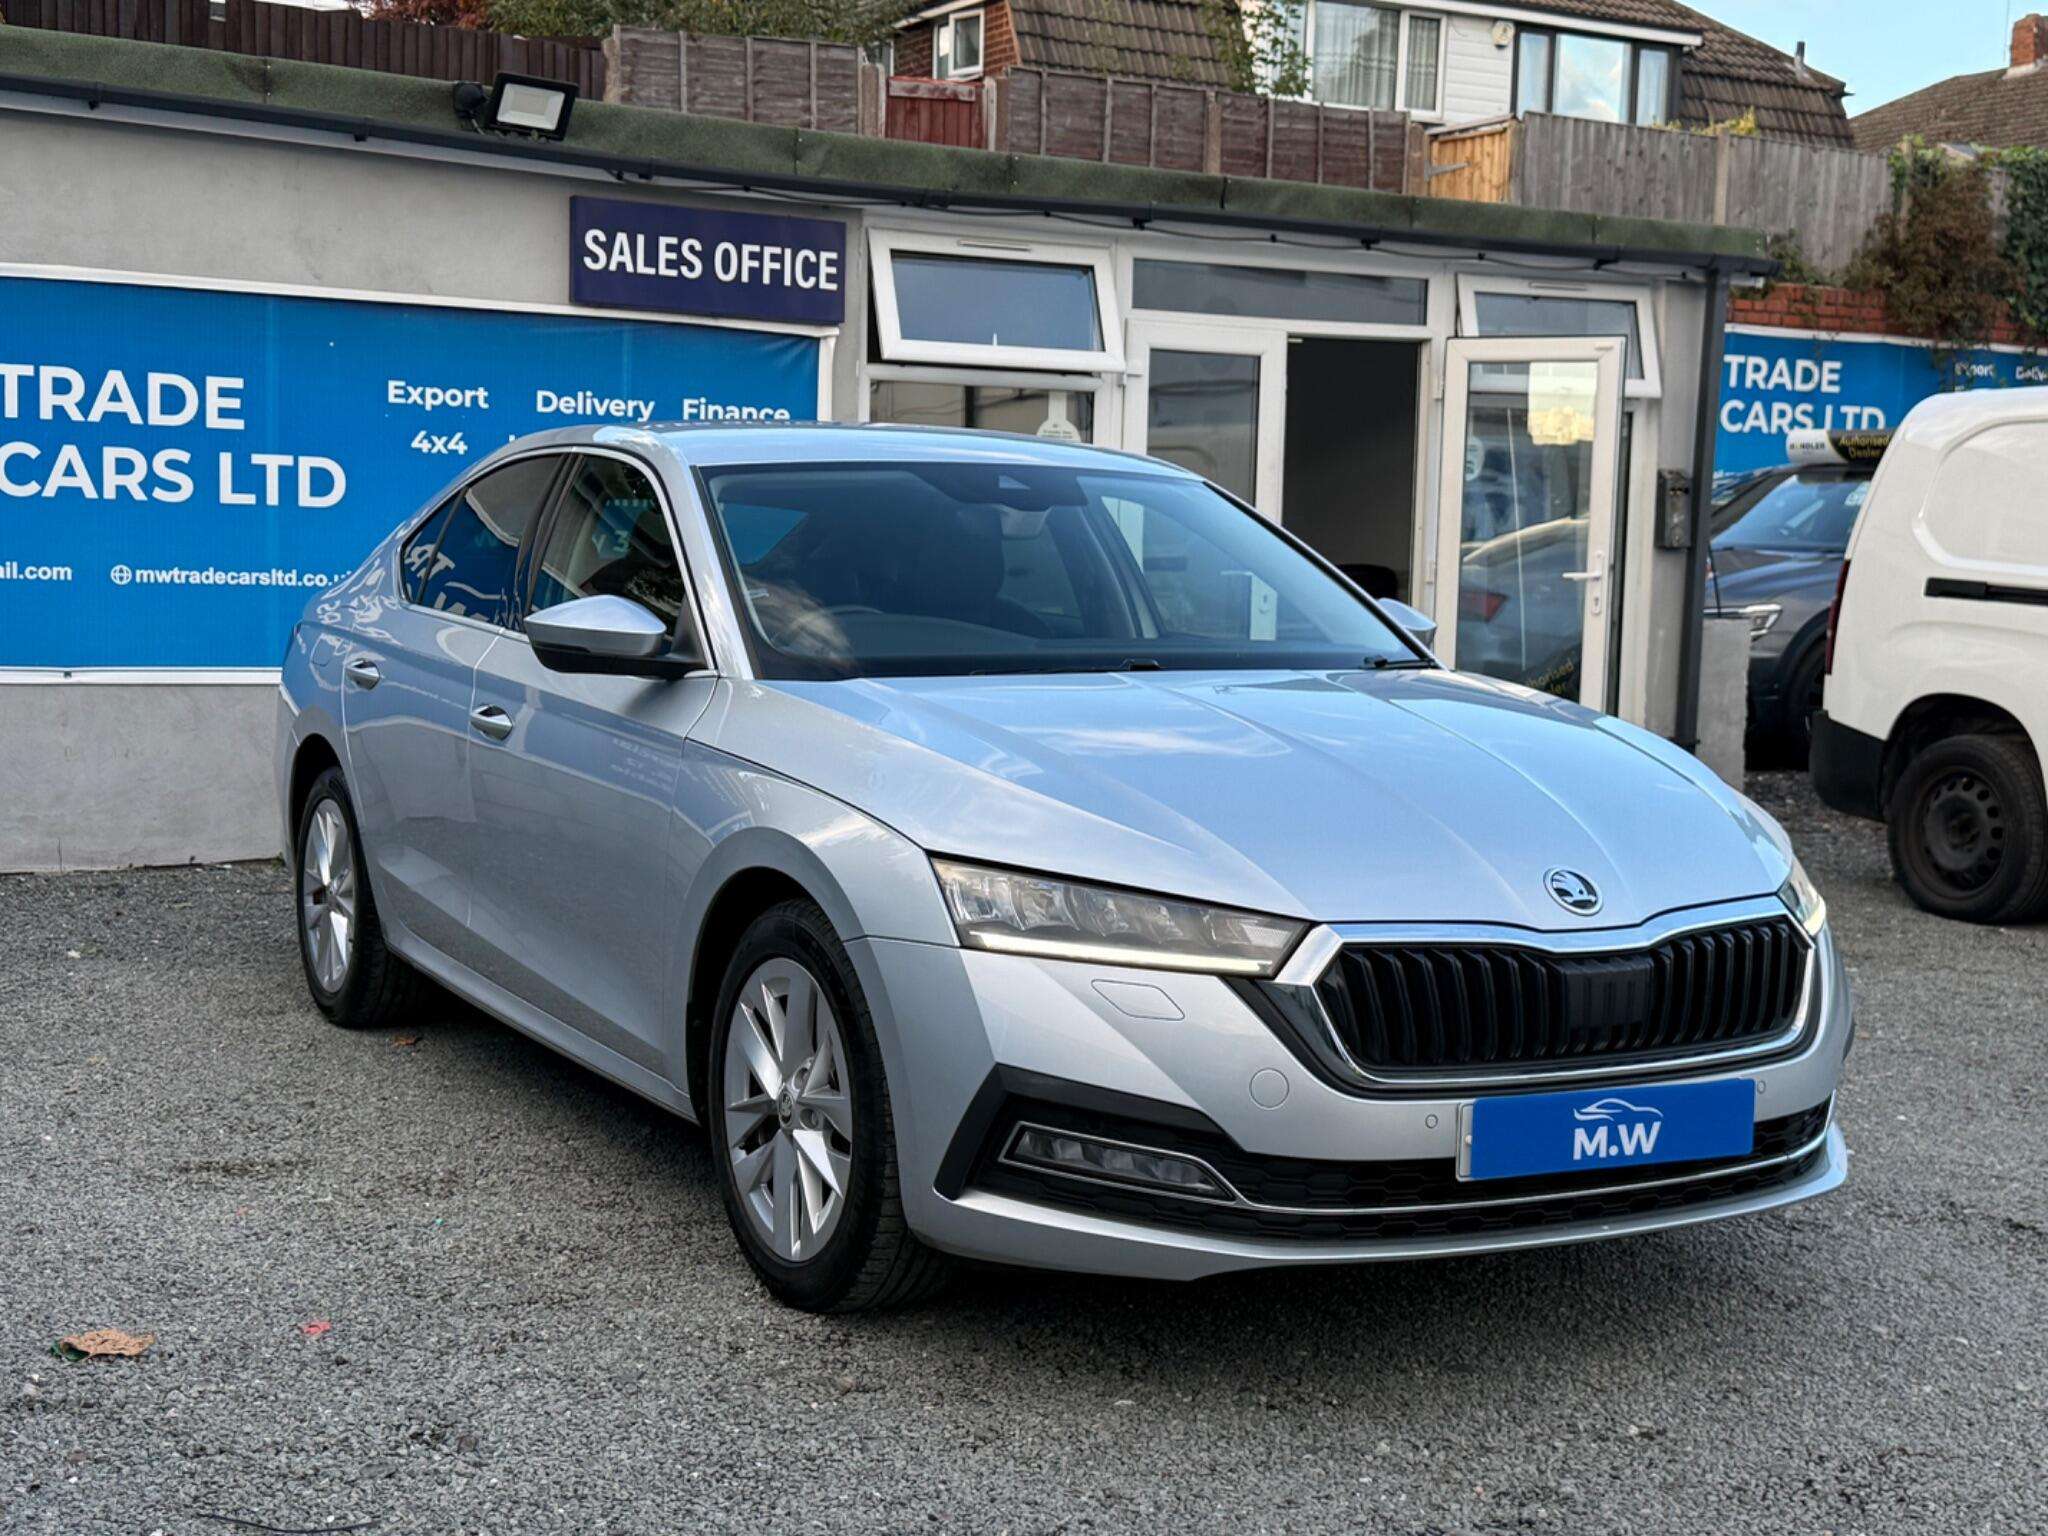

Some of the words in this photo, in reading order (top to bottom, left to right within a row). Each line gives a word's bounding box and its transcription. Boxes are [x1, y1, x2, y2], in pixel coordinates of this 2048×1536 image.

[583, 228, 703, 279] SALES
[714, 241, 838, 290] OFFICE
[1723, 354, 1842, 394] TRADE
[0, 363, 245, 430] TRADE
[388, 380, 490, 411] Export
[536, 390, 655, 422] Delivery
[683, 397, 790, 421] Finance
[1720, 399, 1815, 435] CARS
[411, 430, 468, 455] 4x4
[0, 441, 194, 503] CARS
[219, 452, 346, 508] LTD
[1573, 1121, 1662, 1160] M.W
